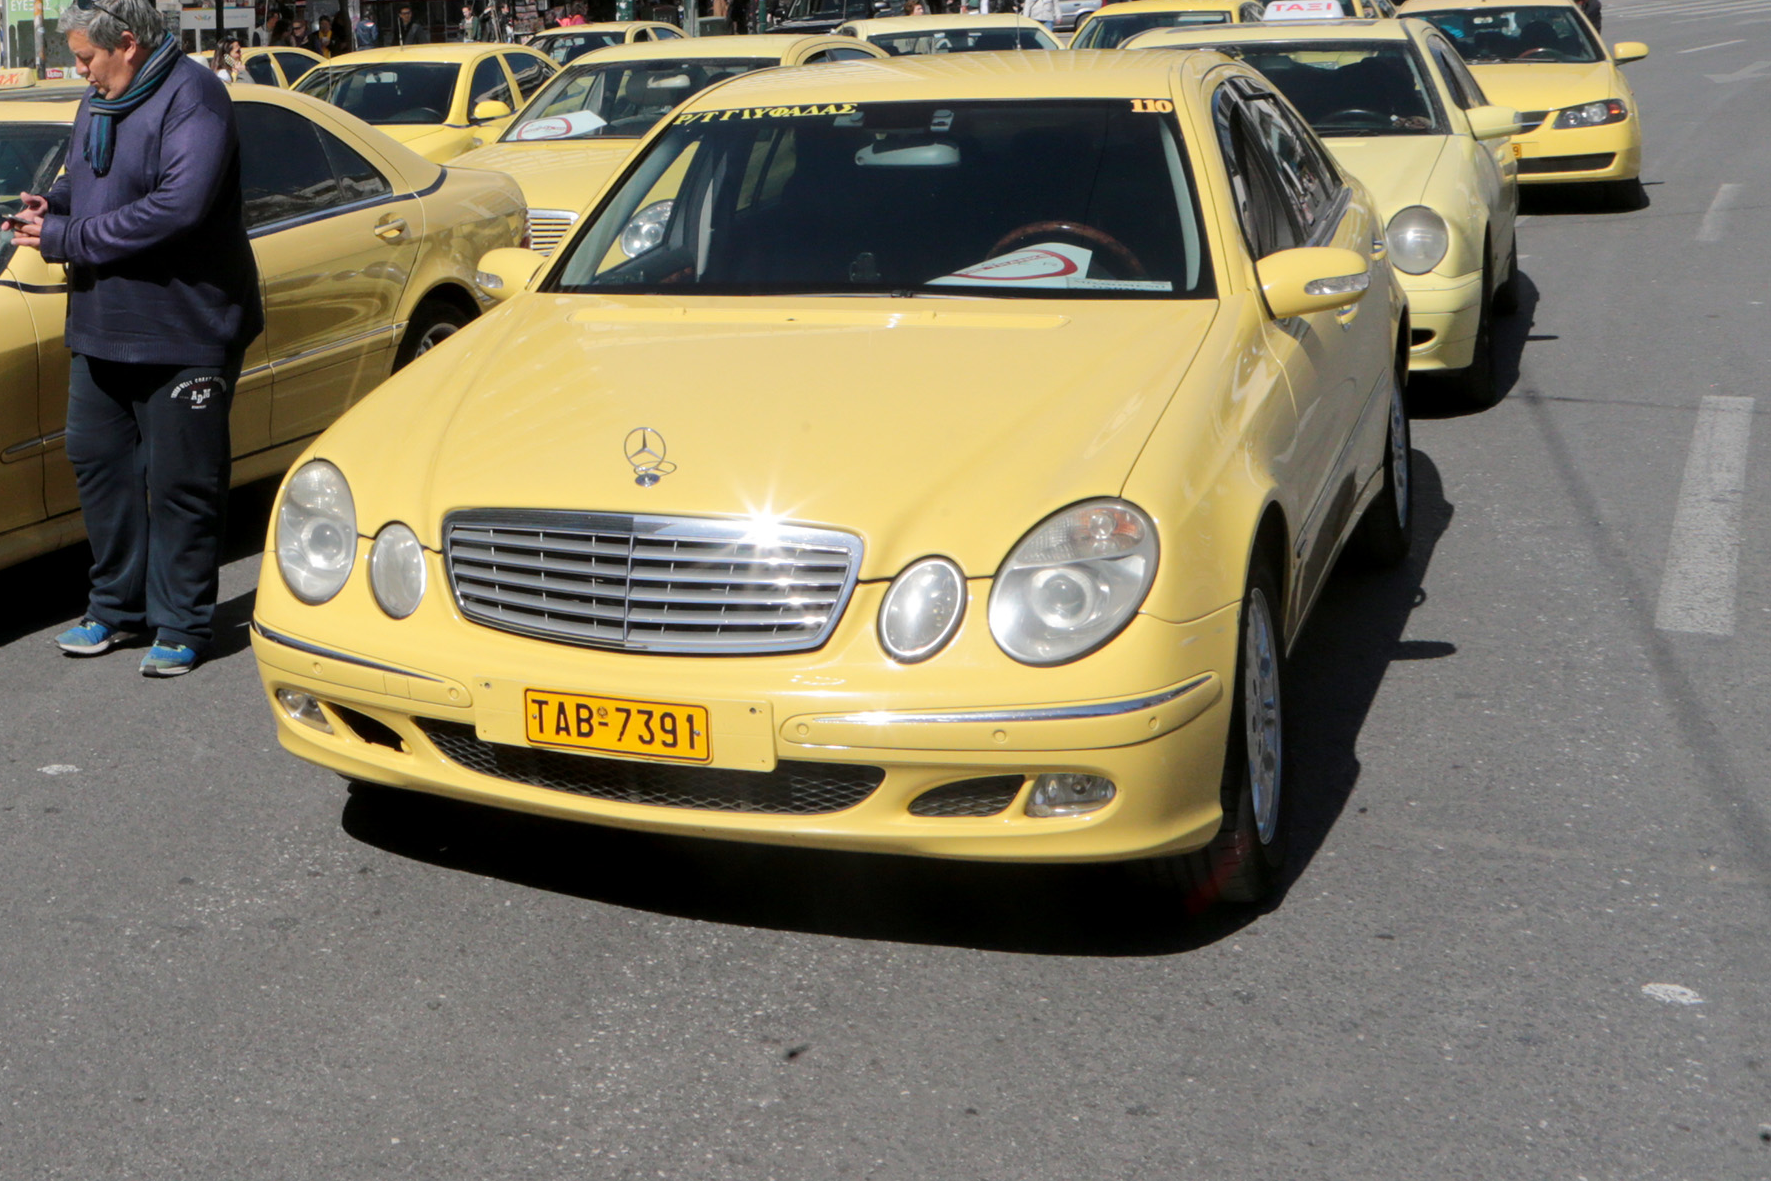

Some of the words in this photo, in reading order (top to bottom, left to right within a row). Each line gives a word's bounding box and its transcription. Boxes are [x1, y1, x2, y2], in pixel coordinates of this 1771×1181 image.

[1272, 2, 1333, 12] ΤΑΞΙ
[1131, 99, 1173, 113] 110
[531, 698, 696, 750] TAB-7391
